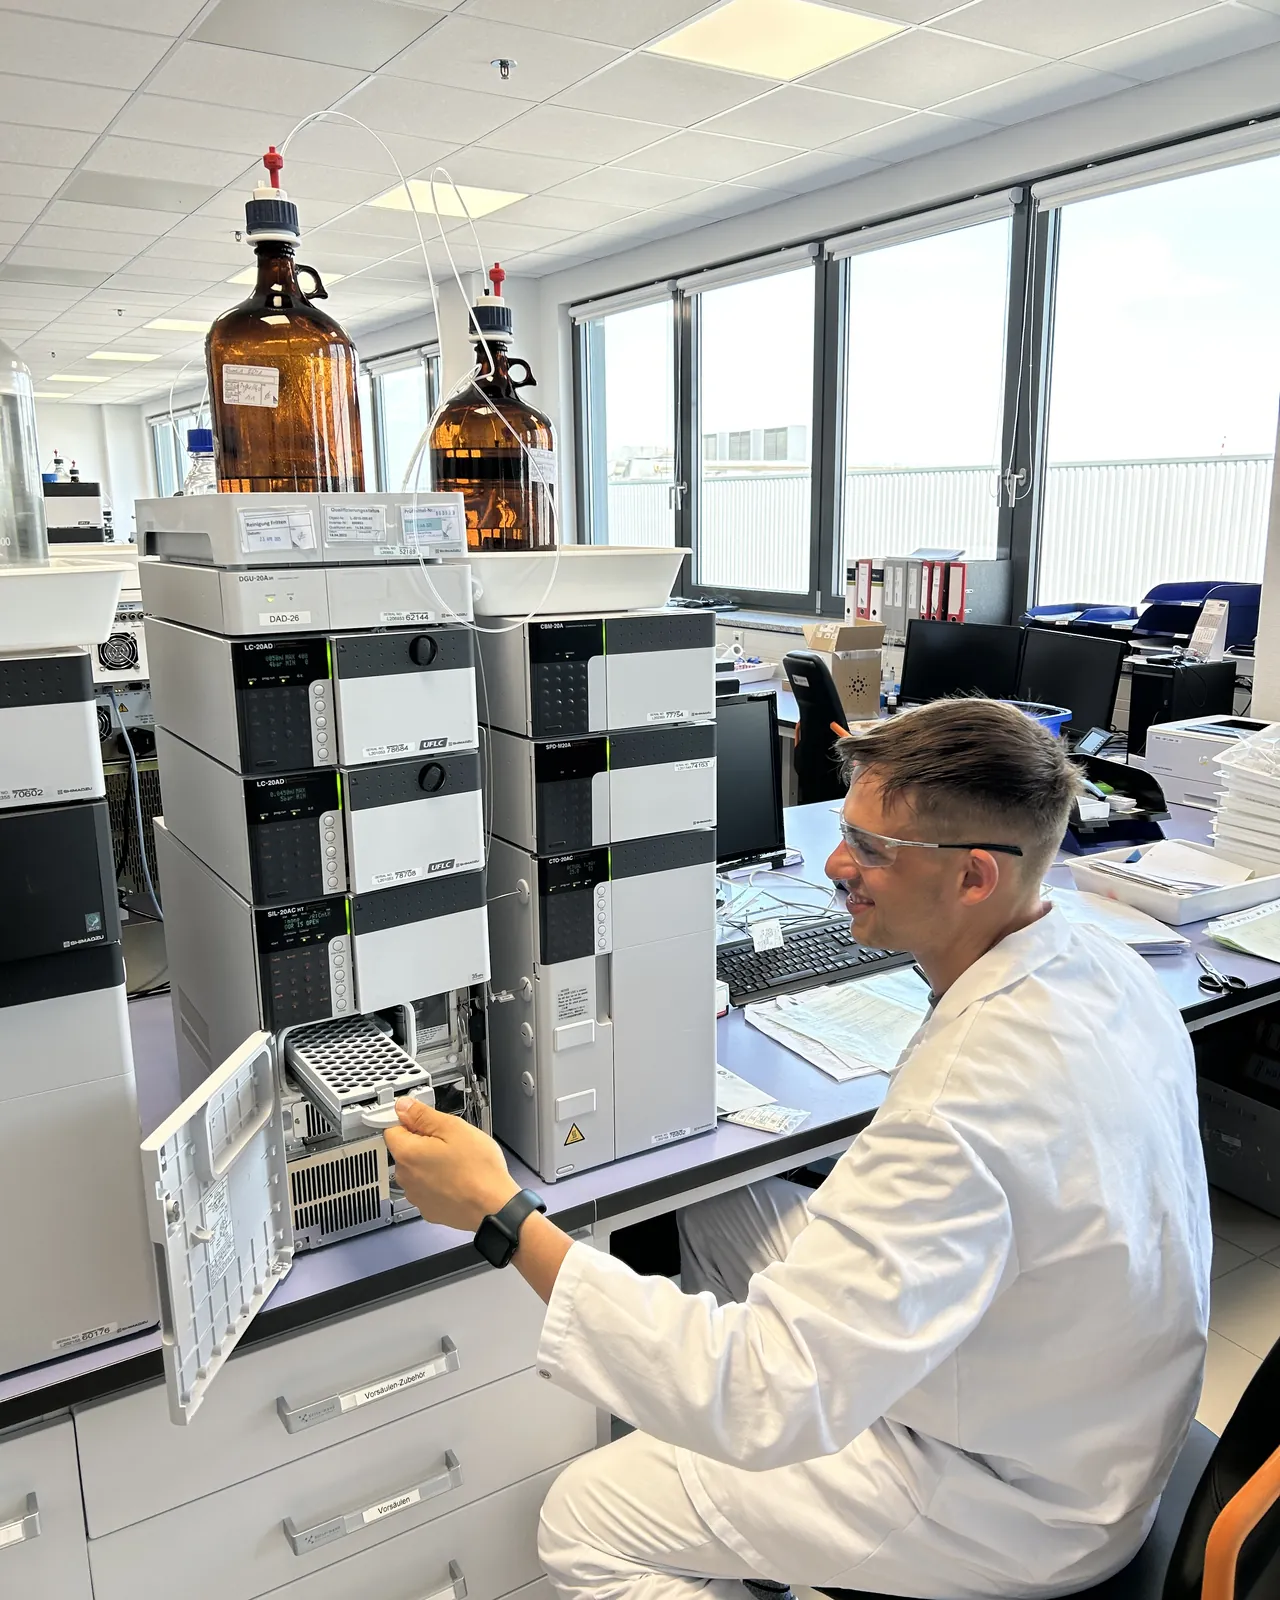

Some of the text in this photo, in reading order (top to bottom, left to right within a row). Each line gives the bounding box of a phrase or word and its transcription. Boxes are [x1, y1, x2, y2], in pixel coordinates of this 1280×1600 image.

[423, 740, 444, 748] UFLC
[256, 779, 284, 787] LC-20AD
[13, 789, 44, 798] 70602
[431, 862, 452, 870] UFLC
[268, 908, 296, 918] SIL-20AC
[82, 1327, 110, 1340] 60176
[364, 1371, 426, 1400] Vorsäulen-Zubehör
[377, 1496, 411, 1514] Vorsäulen
